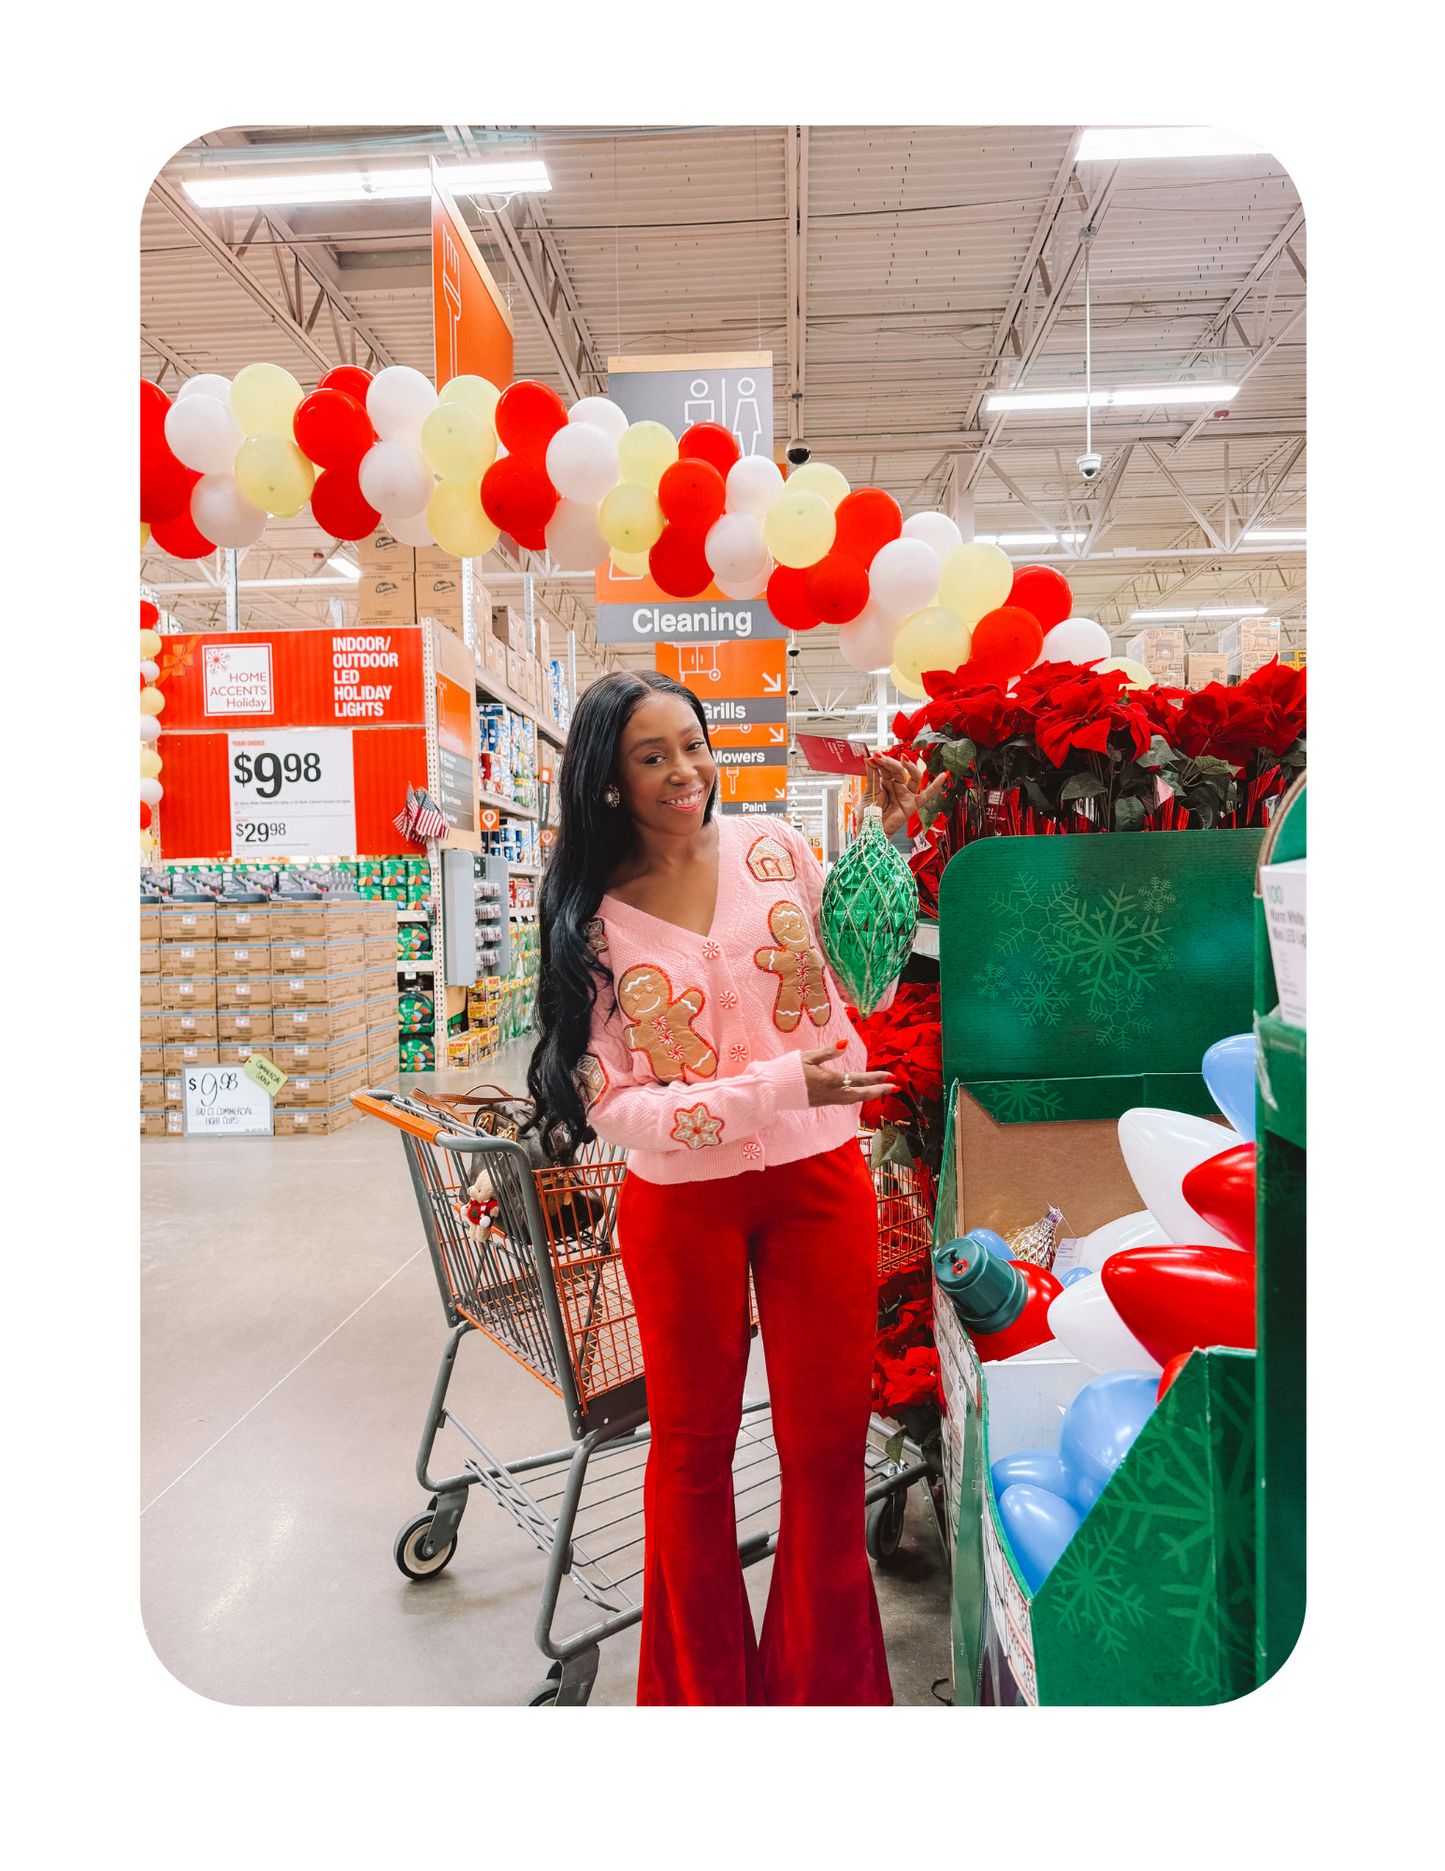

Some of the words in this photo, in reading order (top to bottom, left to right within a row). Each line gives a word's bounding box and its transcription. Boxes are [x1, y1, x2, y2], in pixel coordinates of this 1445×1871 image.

[632, 607, 752, 636] Cleaning
[332, 635, 391, 652] INDOOR/
[333, 652, 399, 668] OUTDOOR
[229, 672, 267, 682] HOME
[333, 669, 360, 685] LED
[210, 685, 267, 696] ACCENTS
[333, 685, 393, 701] HOLIDAY
[226, 697, 267, 711] Holiday
[334, 701, 384, 717] LIGHTS
[701, 702, 746, 719] Grills
[712, 750, 765, 763] Mowers
[742, 802, 767, 812] Paint
